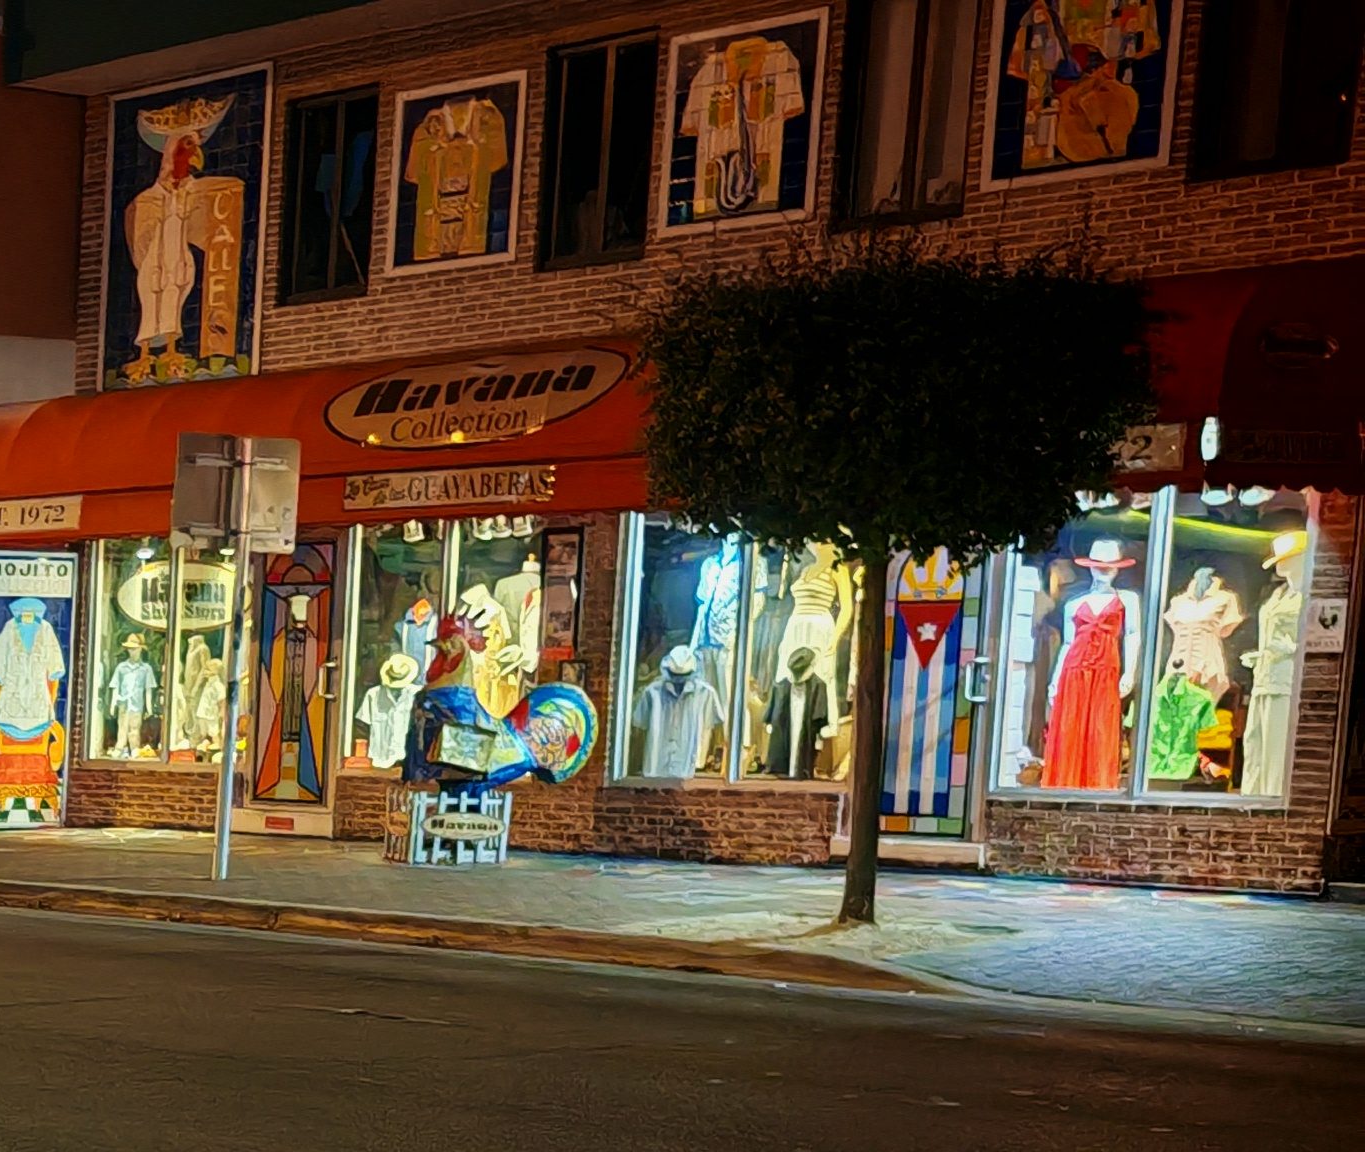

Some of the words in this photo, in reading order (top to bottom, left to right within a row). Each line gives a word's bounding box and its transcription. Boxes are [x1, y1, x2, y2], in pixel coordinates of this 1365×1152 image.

[207, 189, 235, 307] CALLE
[353, 364, 597, 418] Havana
[390, 406, 528, 443] Collection
[406, 467, 553, 502] GUAYABERAS
[18, 503, 66, 526] 1972
